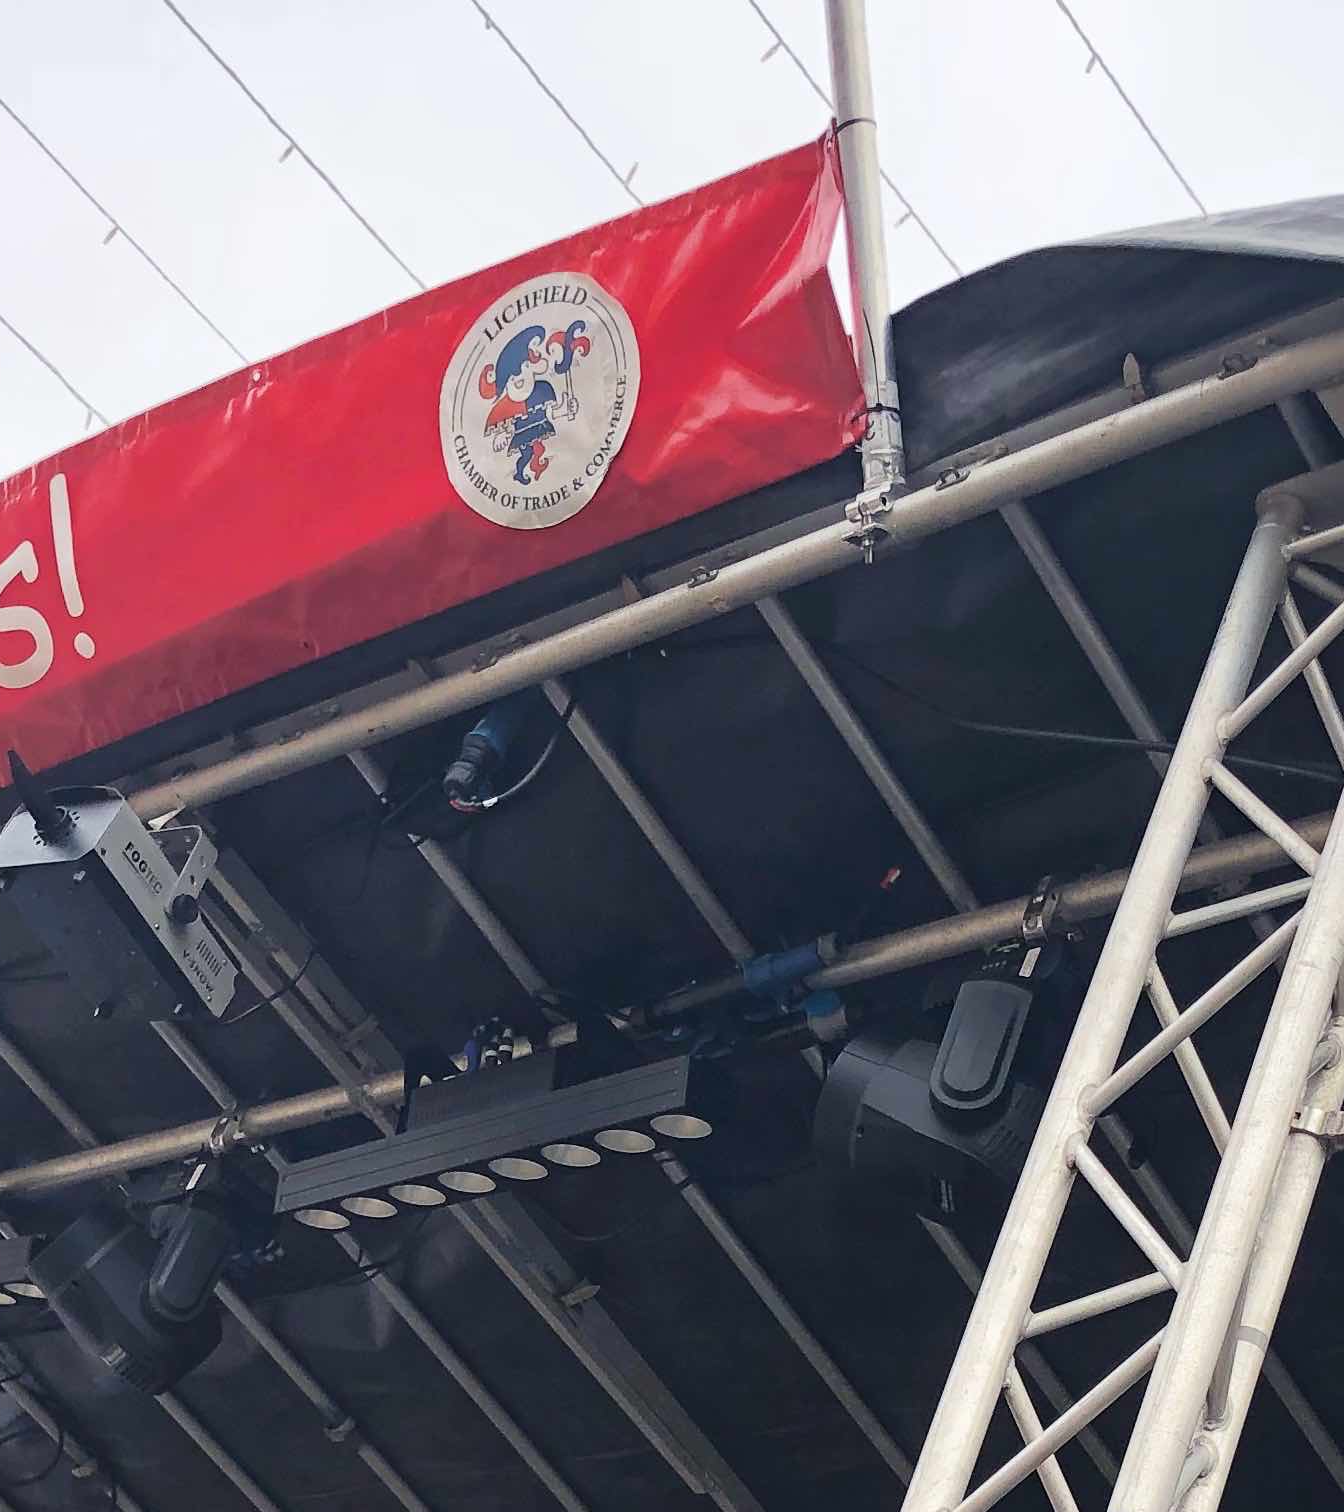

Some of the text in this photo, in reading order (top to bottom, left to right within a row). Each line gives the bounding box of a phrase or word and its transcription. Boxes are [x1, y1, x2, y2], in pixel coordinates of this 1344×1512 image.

[482, 284, 588, 343] LICHFIELD
[454, 434, 499, 502] CHAMBER
[500, 494, 521, 510] OF
[522, 484, 572, 512] TRADE
[573, 476, 585, 491] &
[124, 841, 163, 895] FOGTEC
